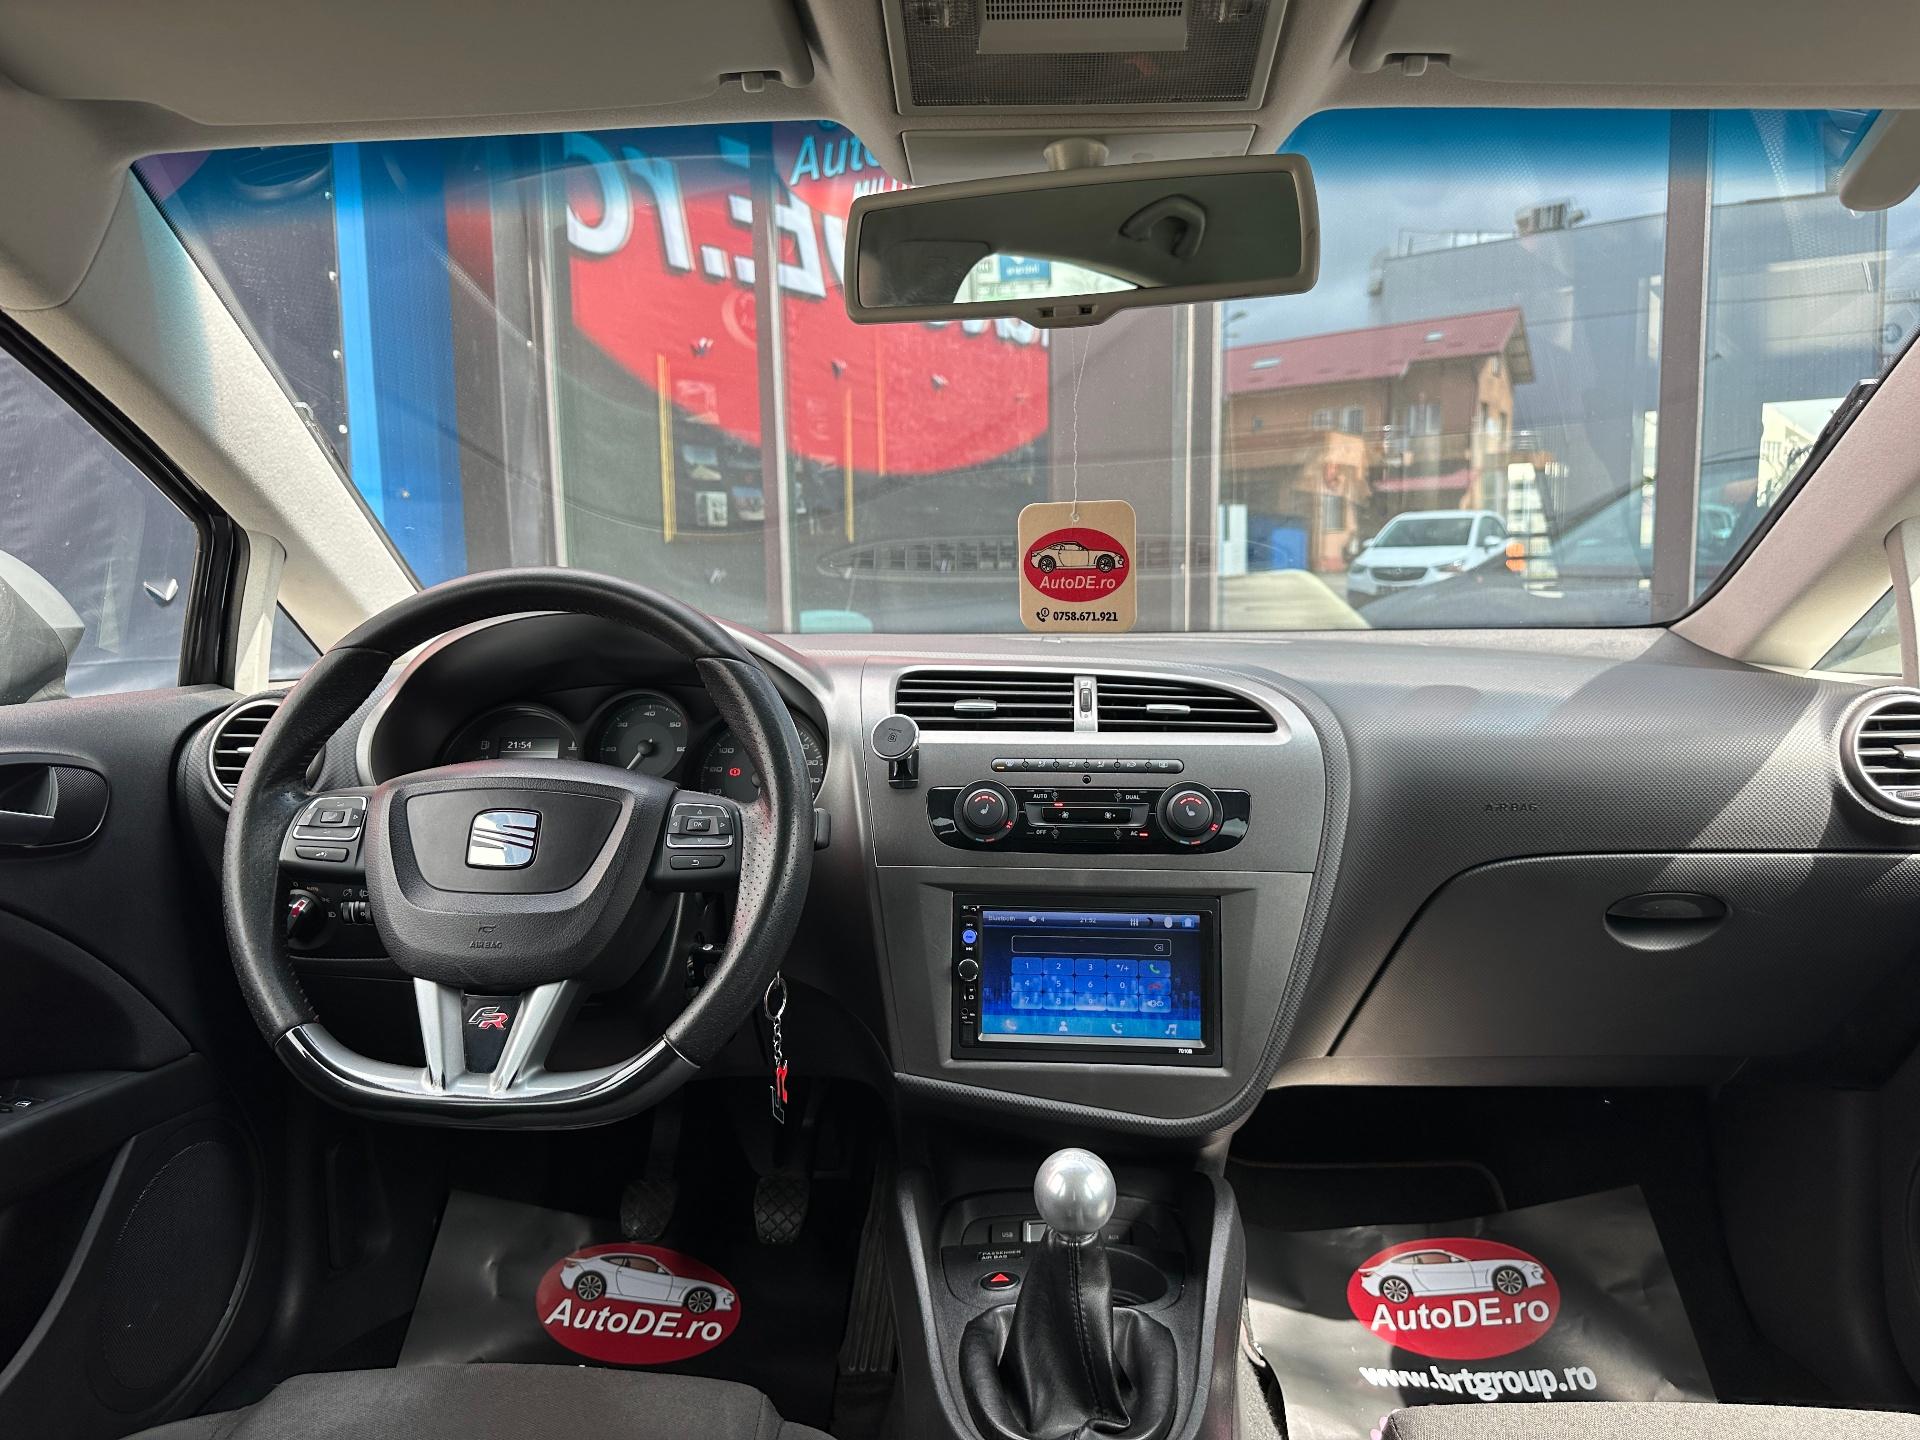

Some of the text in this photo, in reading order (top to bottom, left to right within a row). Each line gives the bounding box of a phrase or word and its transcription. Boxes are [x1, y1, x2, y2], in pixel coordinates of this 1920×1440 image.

[1040, 575, 1116, 589] AutoDE.ro
[1053, 611, 1119, 622] 0758.671.921
[507, 741, 532, 749] 21:54
[469, 940, 503, 950] AIRBAG
[545, 1298, 723, 1341] AutoDE.ro
[1371, 1297, 1550, 1331] AutoDE.ro
[1359, 1365, 1597, 1400] www.brtgroup.ro
